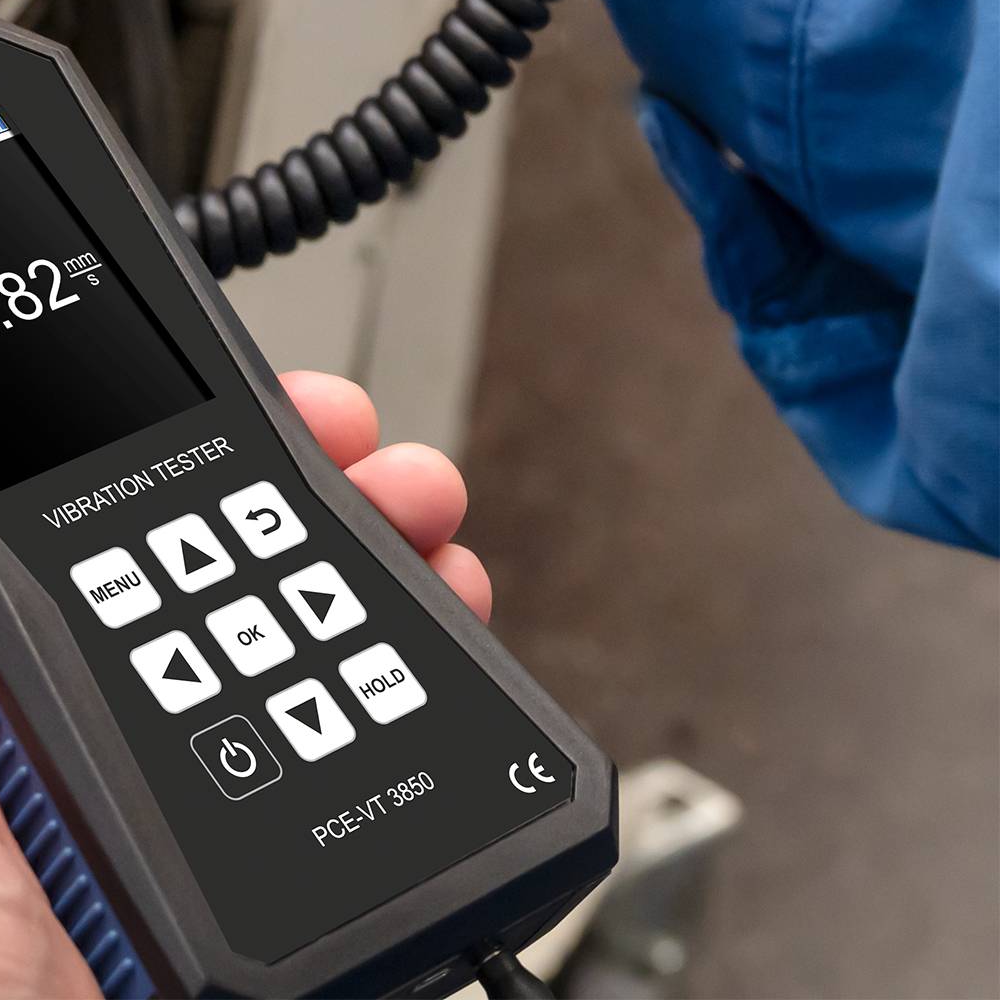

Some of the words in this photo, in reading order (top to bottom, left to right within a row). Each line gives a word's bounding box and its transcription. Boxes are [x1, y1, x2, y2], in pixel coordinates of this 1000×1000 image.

[63, 252, 97, 273] mm
[87, 274, 100, 286] s
[42, 470, 156, 531] VIBRATION
[150, 436, 235, 482] TESTER
[88, 571, 142, 605] MENU
[236, 624, 266, 647] OK
[358, 667, 406, 701] HOLD
[311, 794, 387, 848] PCE-VT
[386, 771, 436, 808] 3850
